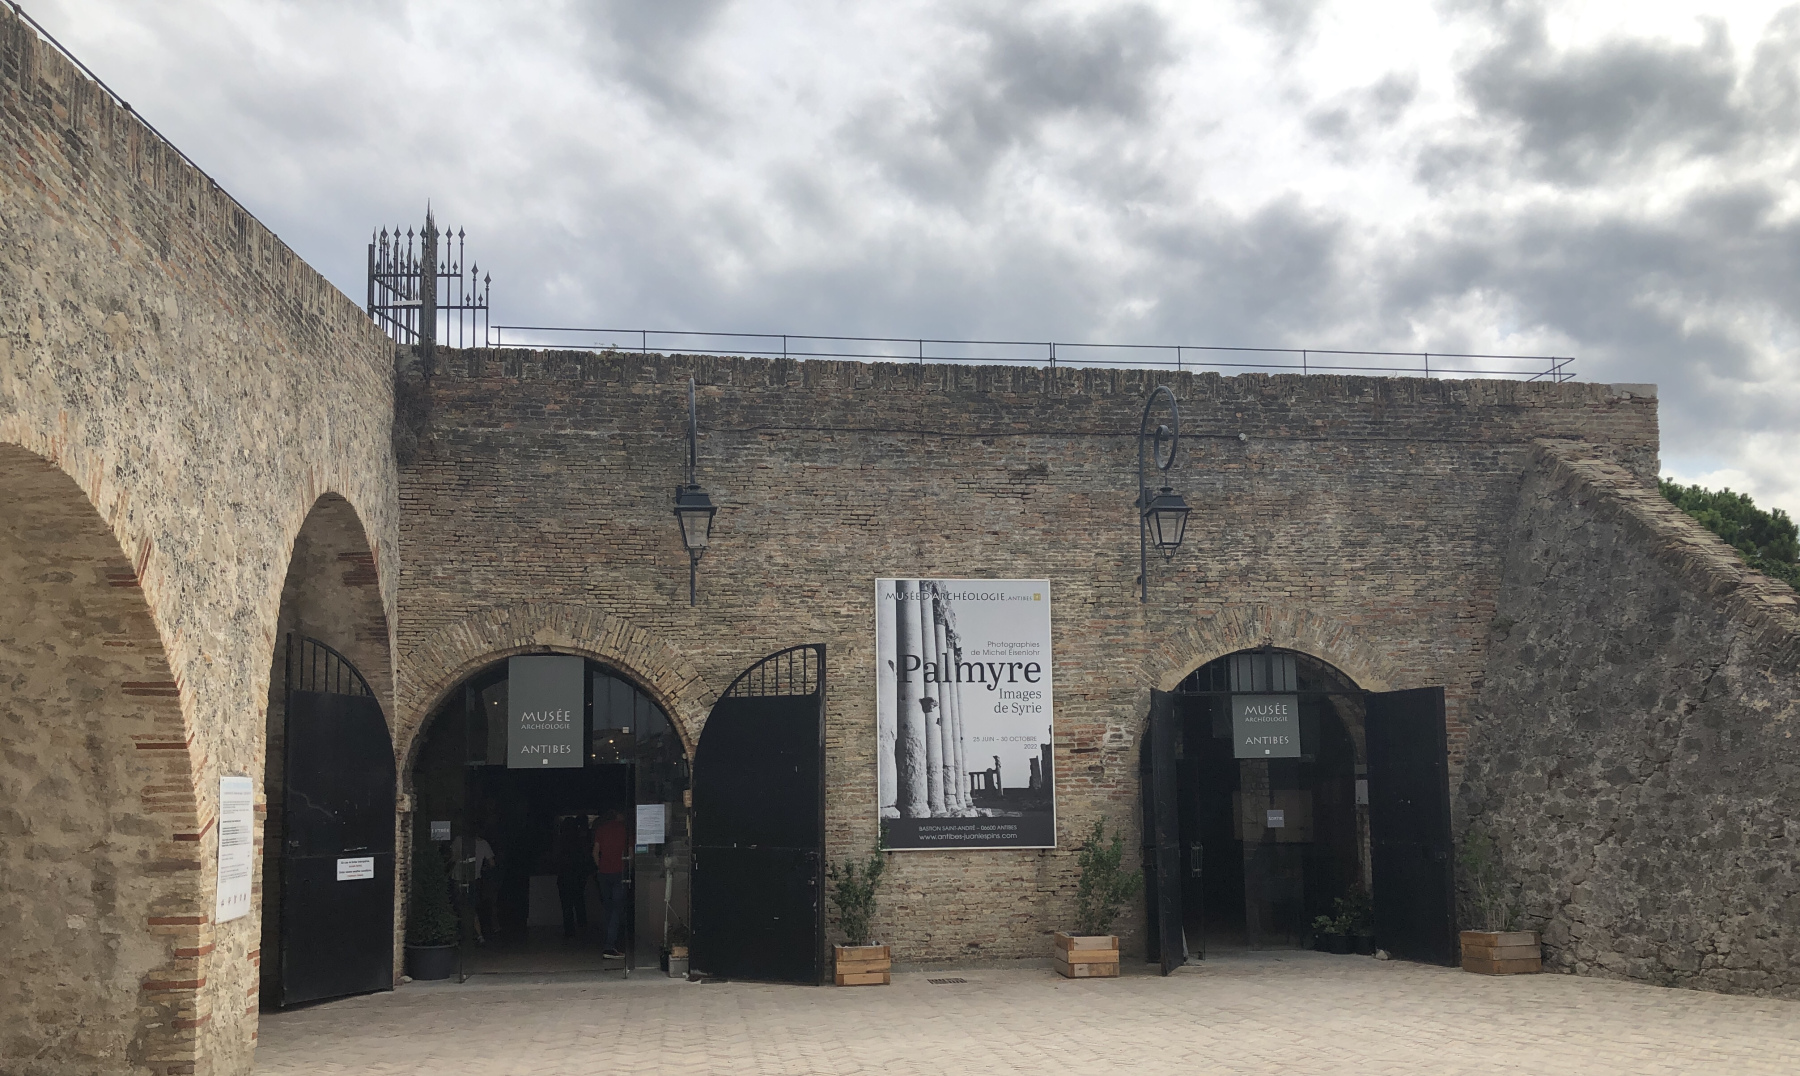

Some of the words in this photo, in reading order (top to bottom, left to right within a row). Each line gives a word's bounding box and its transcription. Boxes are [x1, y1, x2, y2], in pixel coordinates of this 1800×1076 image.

[886, 590, 920, 601] MUSÉE
[987, 641, 1040, 649] Photographies
[1008, 648, 1041, 656] Eisenlohr
[898, 652, 1042, 691] Palmyre
[999, 688, 1042, 702] Images
[993, 701, 1009, 714] de
[1011, 701, 1042, 716] Syrie
[1244, 702, 1288, 716] MUSÉE
[520, 708, 571, 722] MUSÉE
[1245, 735, 1290, 745] ANTIBES
[520, 744, 571, 754] ANTIBES
